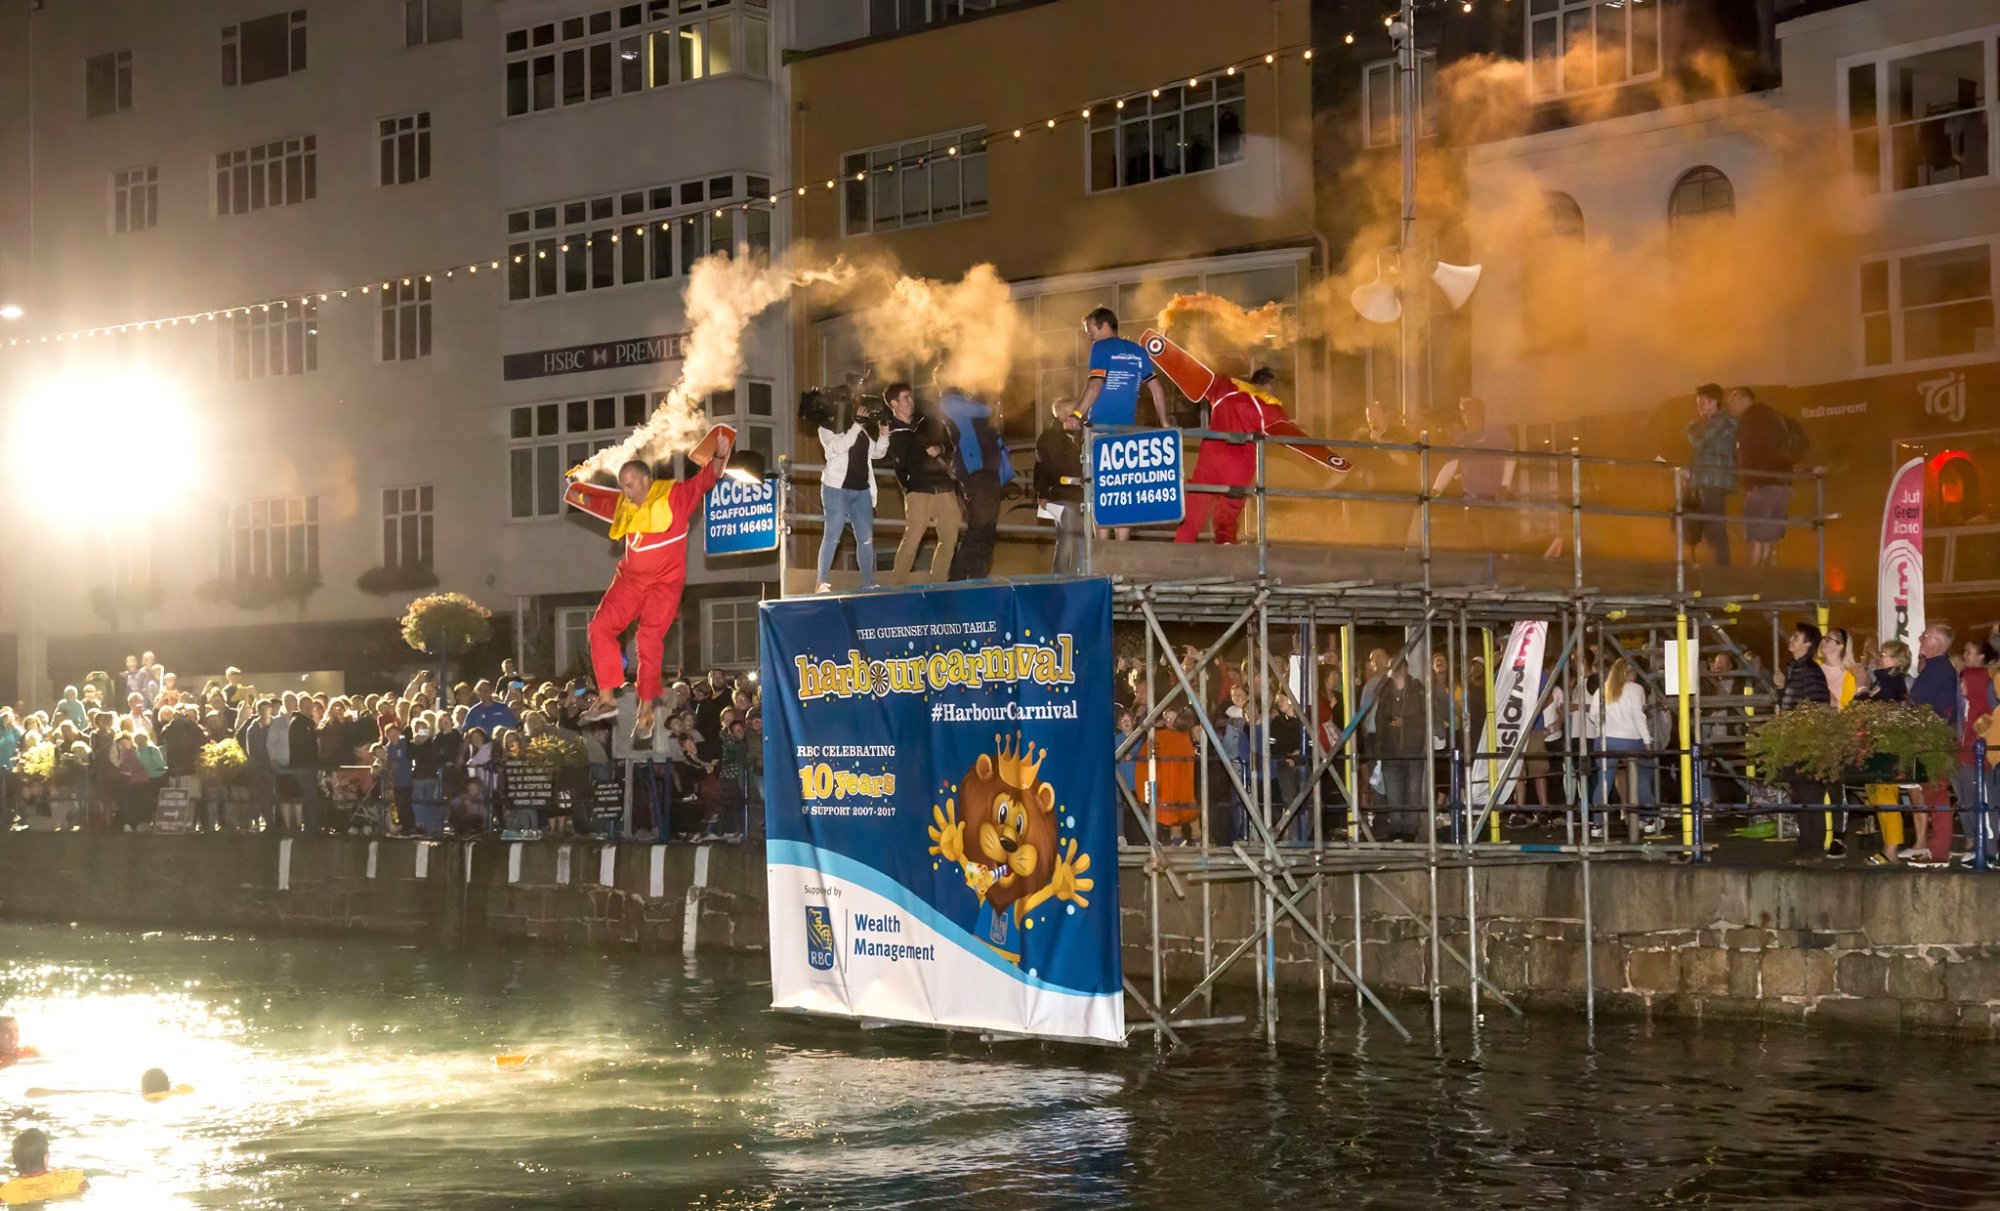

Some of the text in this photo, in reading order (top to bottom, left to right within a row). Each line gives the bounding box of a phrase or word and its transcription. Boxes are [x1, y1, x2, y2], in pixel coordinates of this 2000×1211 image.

[544, 350, 585, 373] HSBC
[1916, 372, 1967, 422] Taj
[1099, 436, 1176, 471] ACCESS
[1099, 469, 1176, 487] SCAFFOLDING
[710, 479, 773, 508] ACCESS
[1100, 487, 1177, 506] 07781 146493
[710, 503, 773, 521] SCAFFOLDING
[710, 519, 773, 538] 07781 146493
[856, 621, 996, 640] THE GUERNSEY ROUND TABLE
[931, 700, 1078, 722] #HarbourCarnival
[797, 745, 896, 757] RBC CELEBRATING
[798, 763, 896, 800] 10 years
[811, 806, 850, 816] SUPPORT
[833, 885, 842, 898] by
[854, 913, 901, 933] Wealth
[811, 951, 832, 966] RBC
[854, 938, 935, 962] Management
